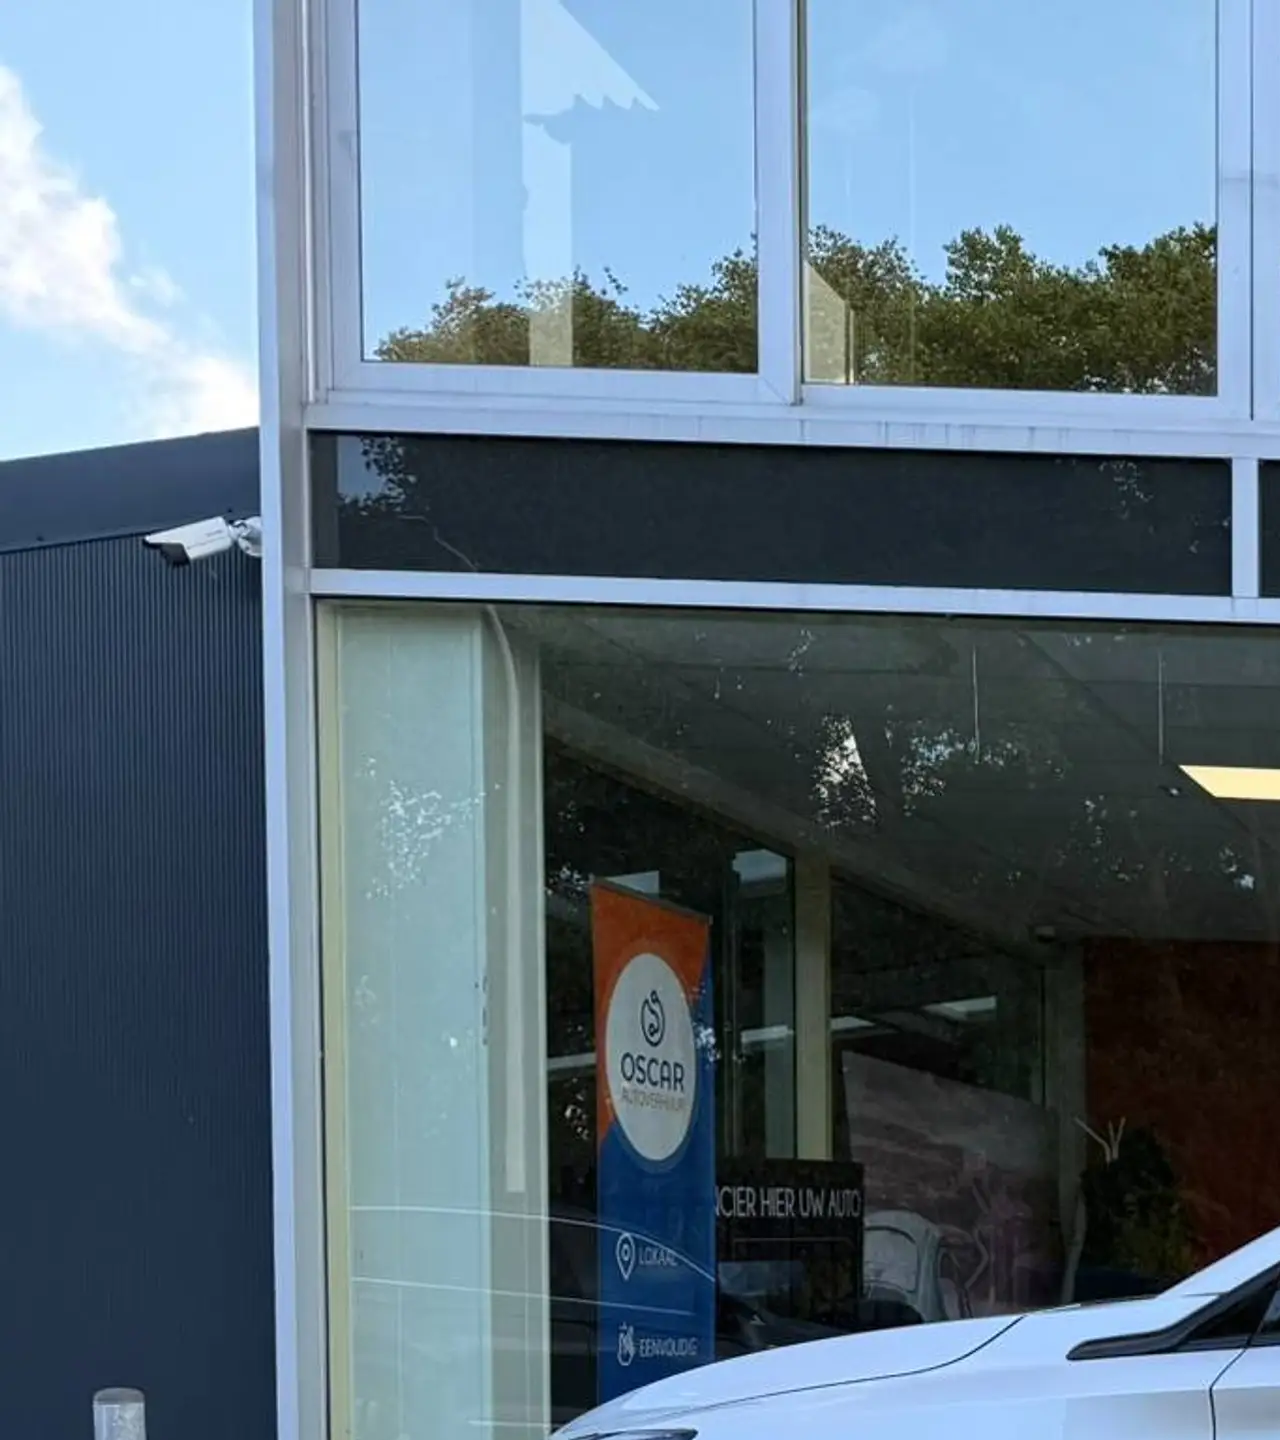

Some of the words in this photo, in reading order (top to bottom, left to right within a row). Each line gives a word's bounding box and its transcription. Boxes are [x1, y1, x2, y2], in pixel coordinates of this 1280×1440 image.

[621, 1052, 684, 1093] OSCAR
[760, 1187, 796, 1218] HIER
[799, 1187, 825, 1218] UW
[828, 1188, 861, 1218] AUTO
